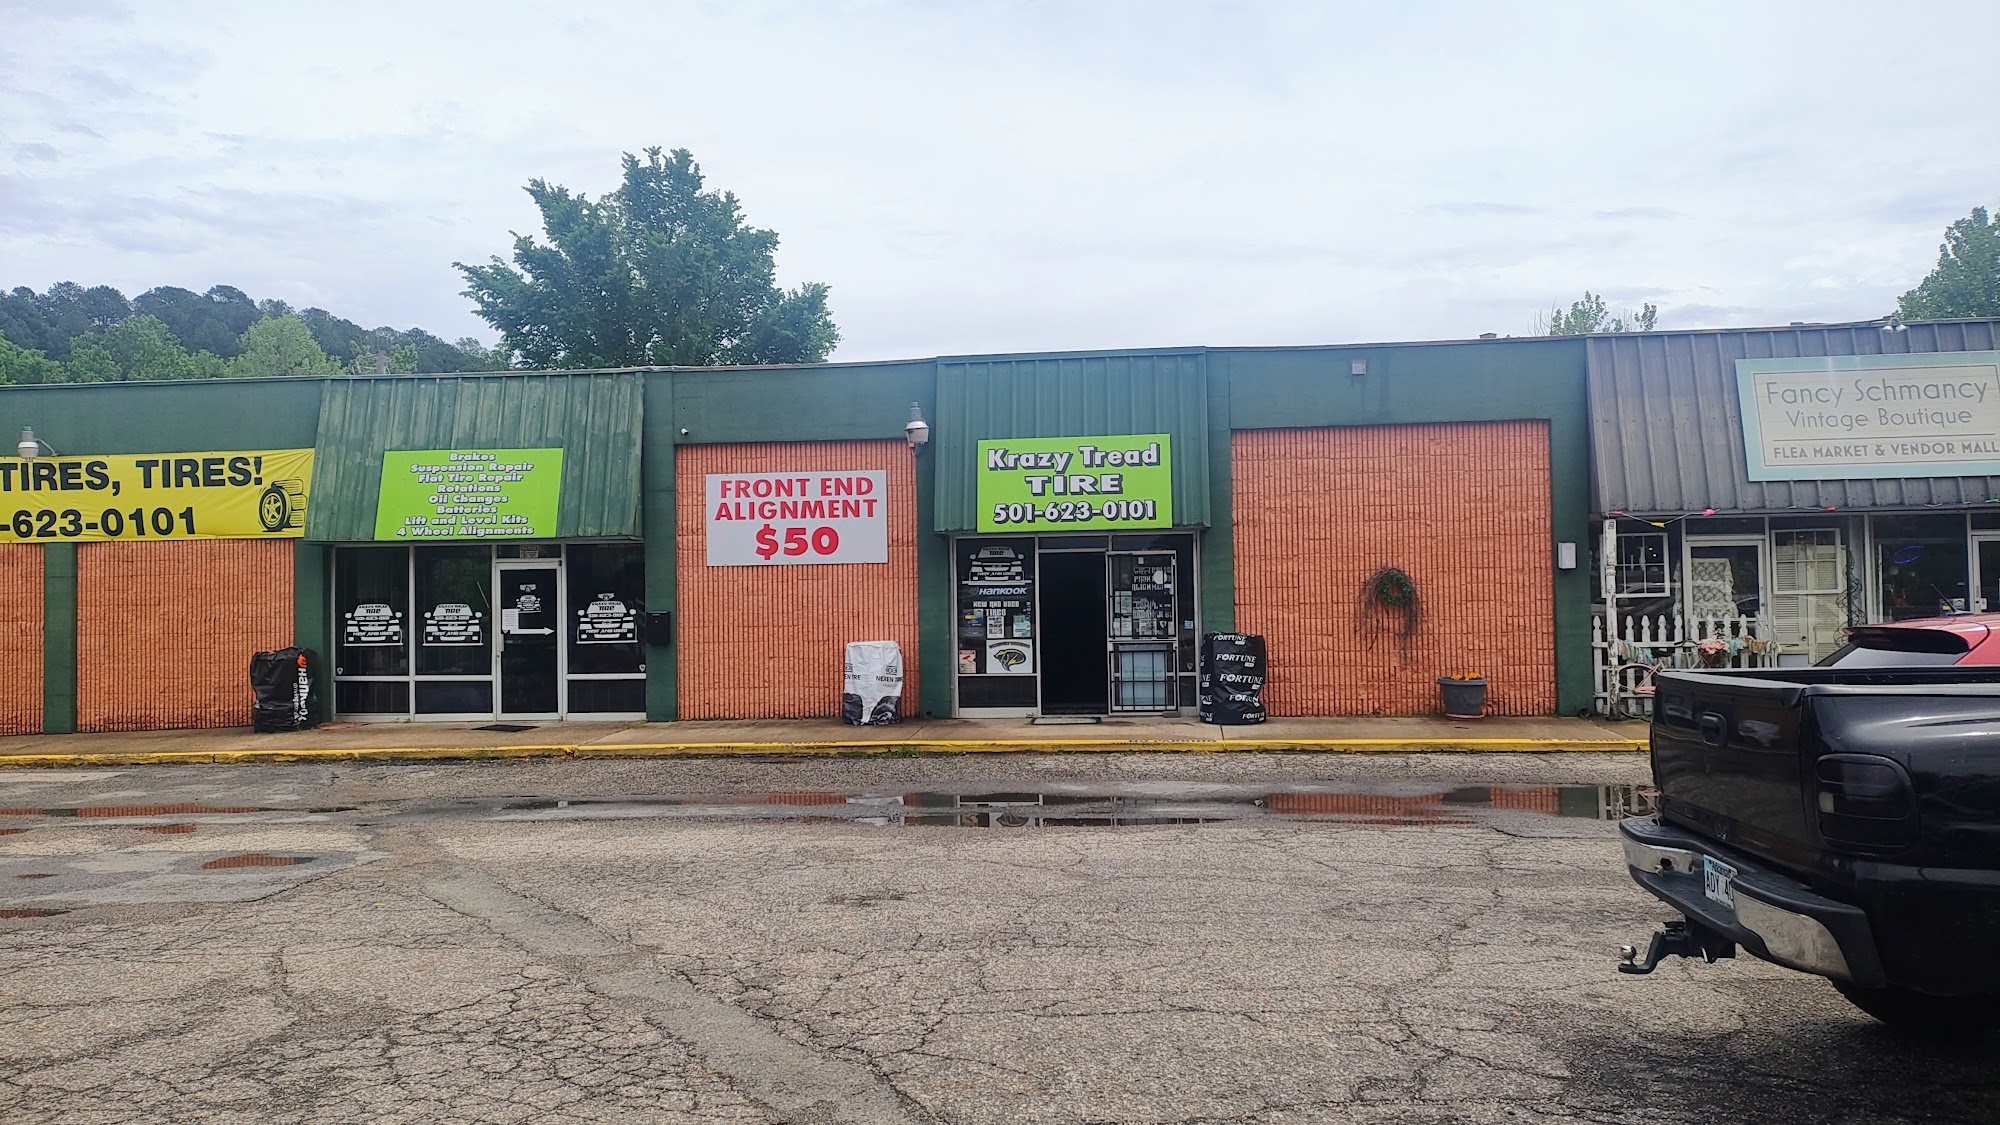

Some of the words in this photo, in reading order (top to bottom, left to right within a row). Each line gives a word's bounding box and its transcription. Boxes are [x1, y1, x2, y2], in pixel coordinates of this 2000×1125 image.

[1766, 382, 1843, 408] Fancy
[1854, 378, 1987, 403] Schmancy
[1785, 410, 1868, 431] Vintage
[1878, 407, 1972, 428] Boutique
[1773, 447, 1808, 459] FLEA
[1813, 445, 1869, 458] MARKET
[1874, 444, 1885, 456] &
[1890, 442, 1955, 456] VENDOR
[1961, 441, 2000, 454] MALL
[449, 453, 496, 461] Brakes
[988, 448, 1073, 474] Krazy
[1078, 442, 1160, 468] Tread
[410, 463, 483, 473] Suspension
[488, 462, 534, 473] Repair
[0, 461, 121, 497] TIRES,
[136, 456, 263, 488] TIRES!
[418, 474, 443, 483] Flat
[448, 473, 474, 482] Tire
[478, 473, 523, 483] Repair
[437, 484, 501, 493] Rotations
[720, 478, 810, 498] FRONT
[820, 477, 874, 496] END
[1025, 473, 1123, 496] TIRE
[428, 494, 448, 504] Oil
[453, 494, 508, 505] Changes
[436, 505, 497, 514] Batteries
[715, 499, 877, 521] ALIGNMENT
[993, 499, 1156, 524] 501-623-0101
[404, 516, 427, 525] Lift
[431, 516, 456, 525] and
[461, 515, 496, 525] Level
[501, 515, 528, 524] Kits
[397, 527, 406, 536] 4
[411, 526, 453, 536] Wheel
[457, 526, 534, 537] Alignments
[755, 524, 840, 560] $50
[1213, 634, 1247, 642] FORTUNE
[1216, 653, 1257, 663] FORTUNE
[1219, 673, 1264, 685] FORTUNE
